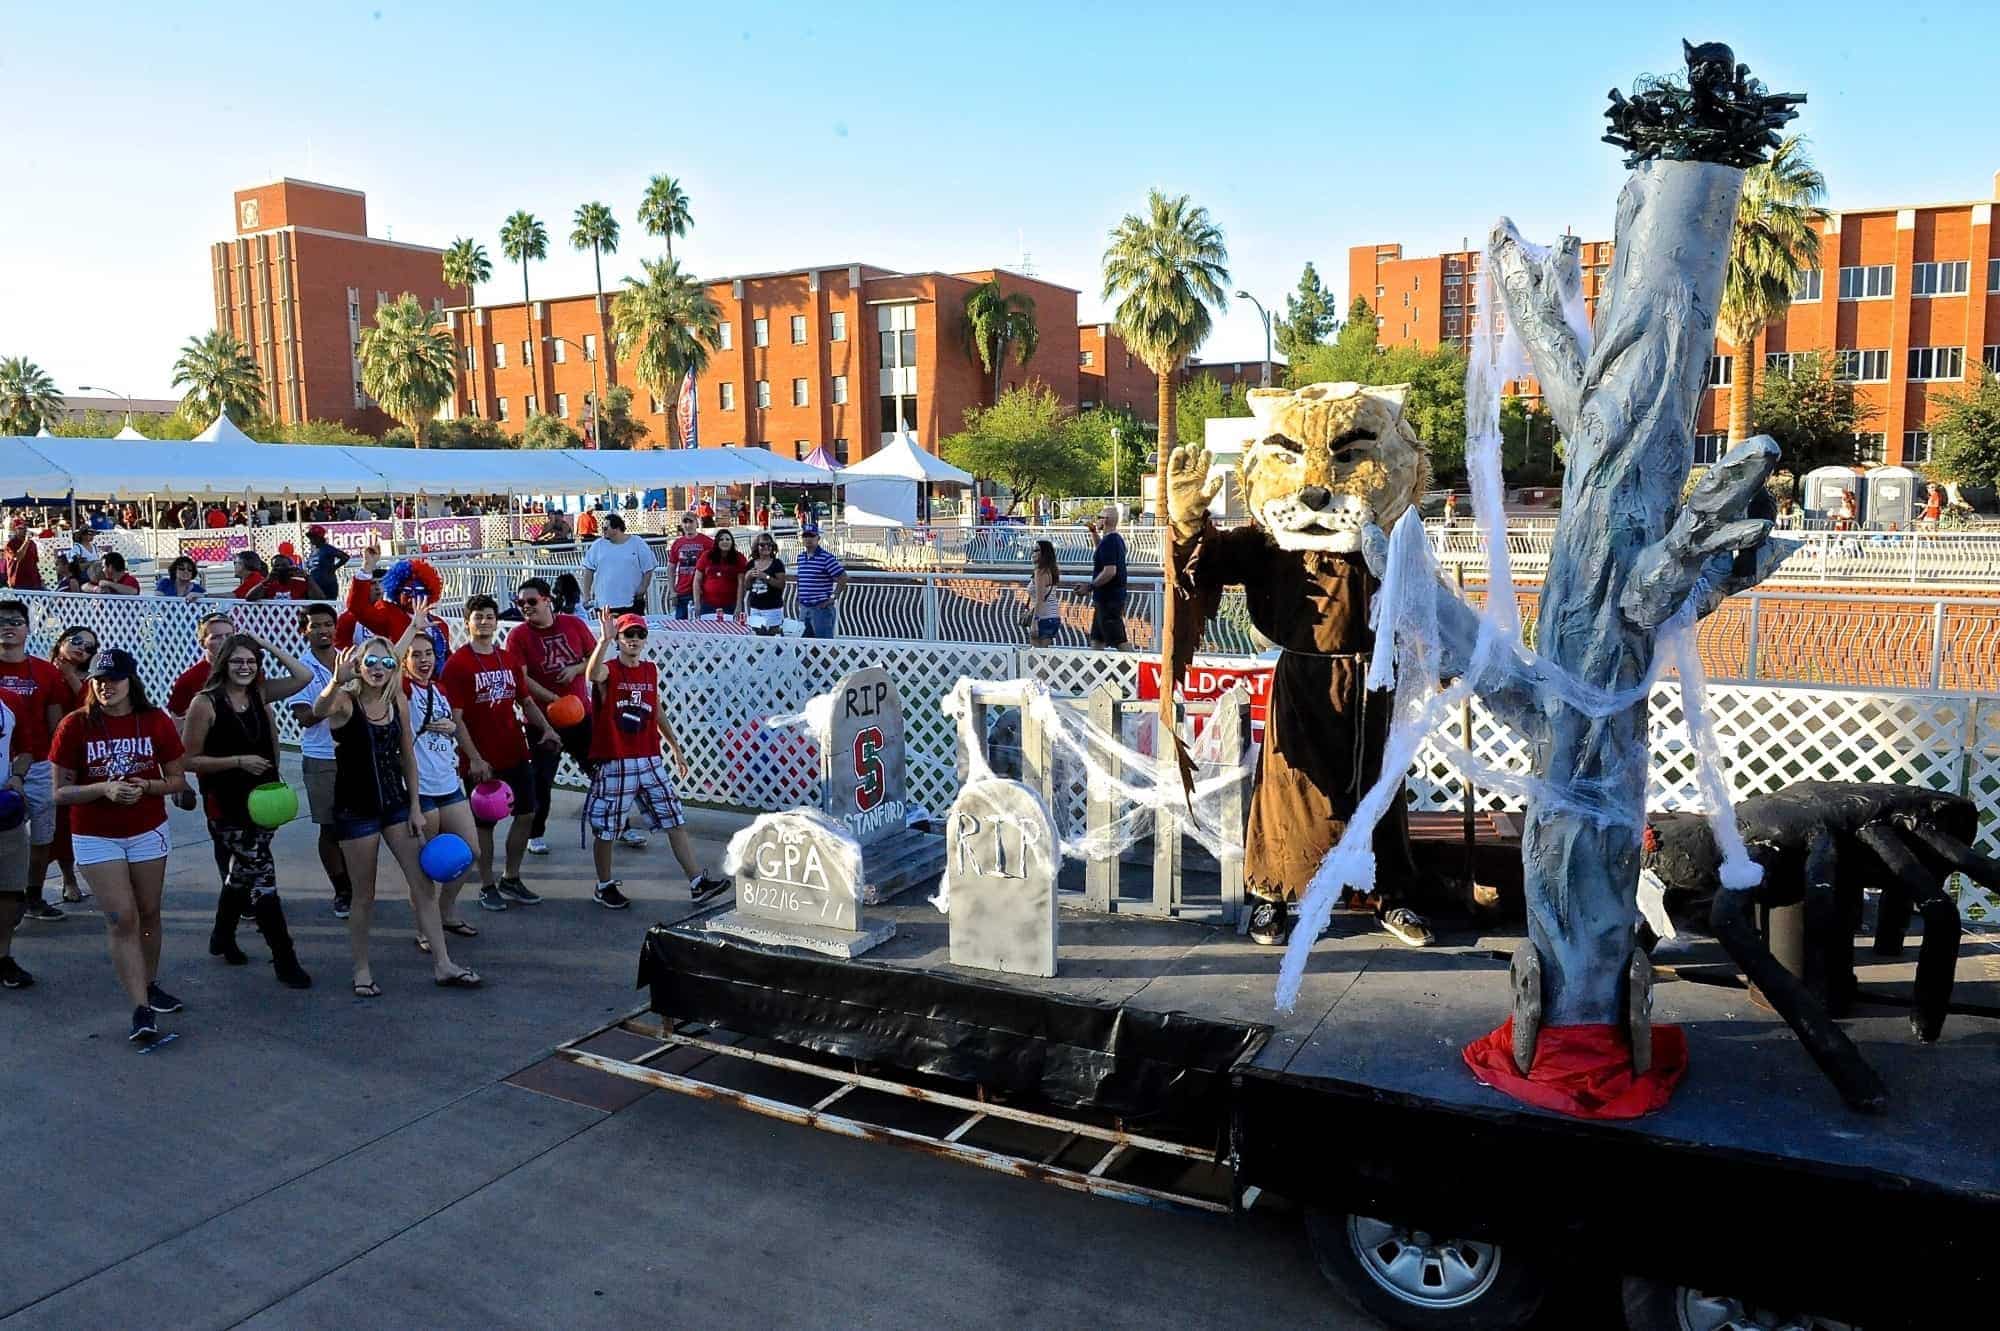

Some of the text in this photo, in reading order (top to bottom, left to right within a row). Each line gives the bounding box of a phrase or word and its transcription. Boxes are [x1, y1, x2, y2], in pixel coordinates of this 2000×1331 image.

[475, 669, 516, 690] ARIZONA
[845, 682, 888, 719] RIP
[87, 736, 153, 764] ARIZONA
[844, 800, 904, 836] STANFORD
[956, 811, 1041, 879] RIP
[756, 841, 829, 891] GPA
